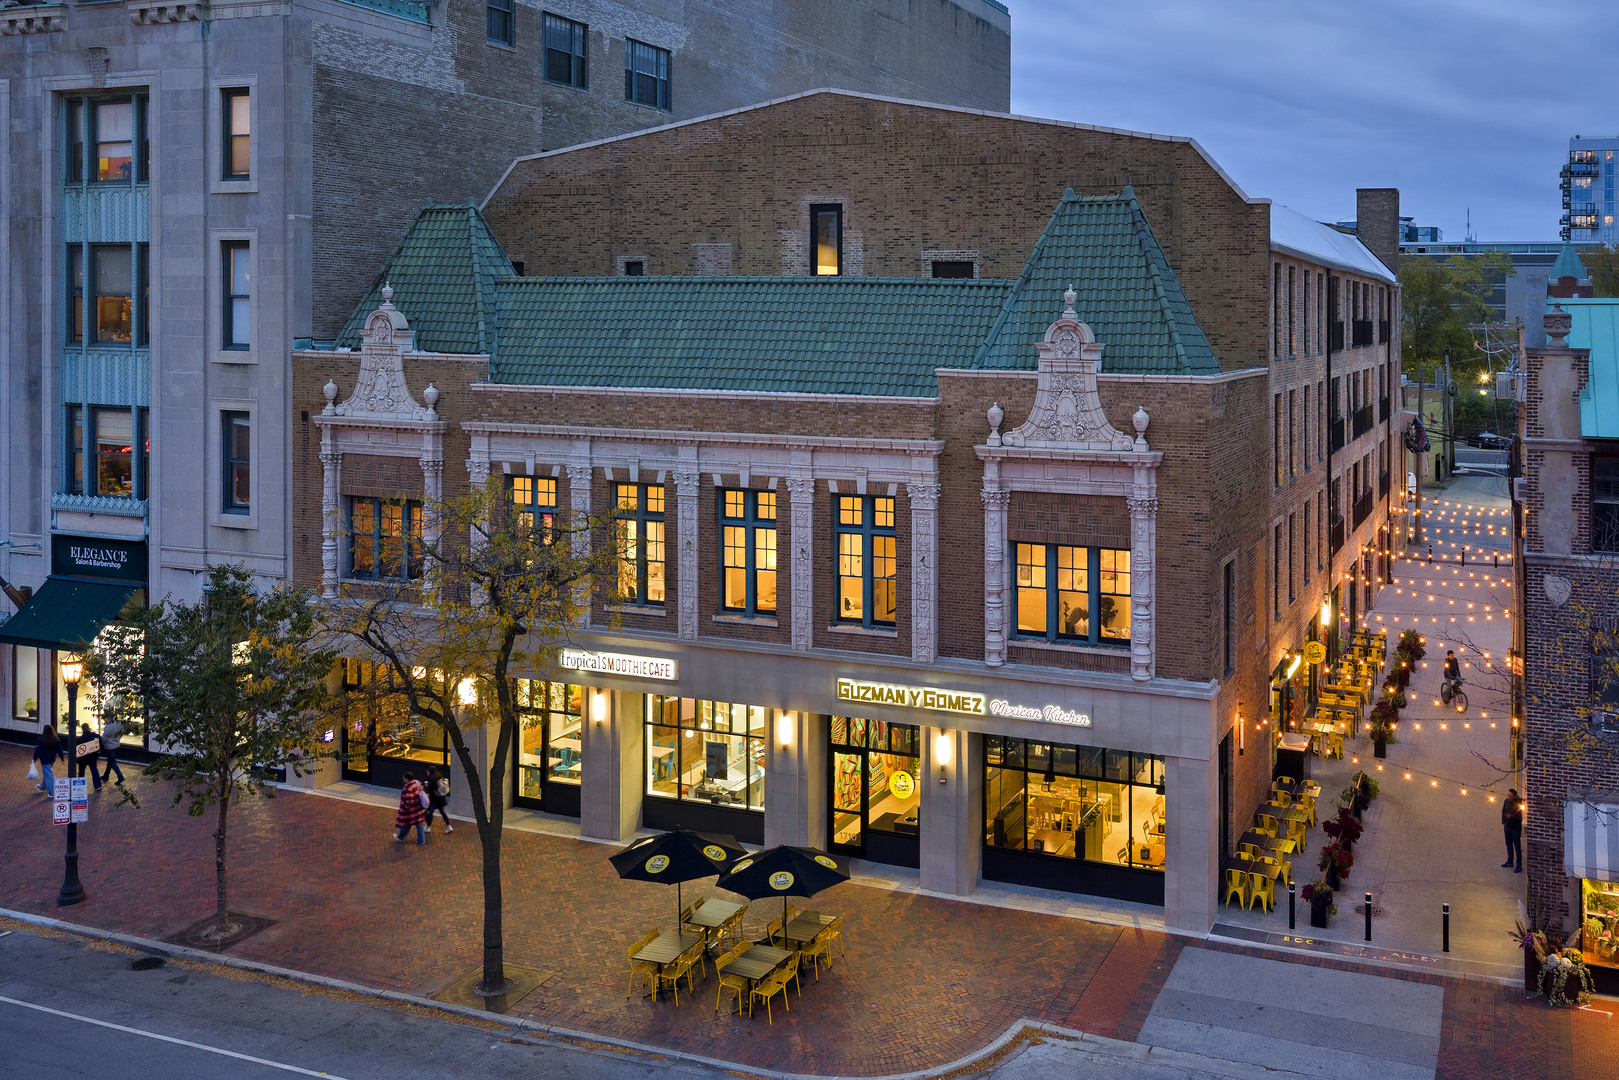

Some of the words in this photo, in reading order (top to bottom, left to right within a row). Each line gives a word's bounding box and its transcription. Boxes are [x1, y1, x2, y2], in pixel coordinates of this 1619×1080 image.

[70, 546, 128, 563] ELEGANCE
[75, 558, 89, 566] Salon
[93, 560, 122, 570] Barbershop
[601, 656, 647, 675] SMOOTHIE
[649, 662, 671, 678] CAFE
[837, 680, 906, 705] GUZMAN
[909, 689, 921, 707] Y
[923, 689, 983, 714] GOMEZ
[989, 699, 1042, 720] Mexican
[1042, 704, 1089, 726] Kitchen
[1390, 951, 1439, 963] ALLEY
